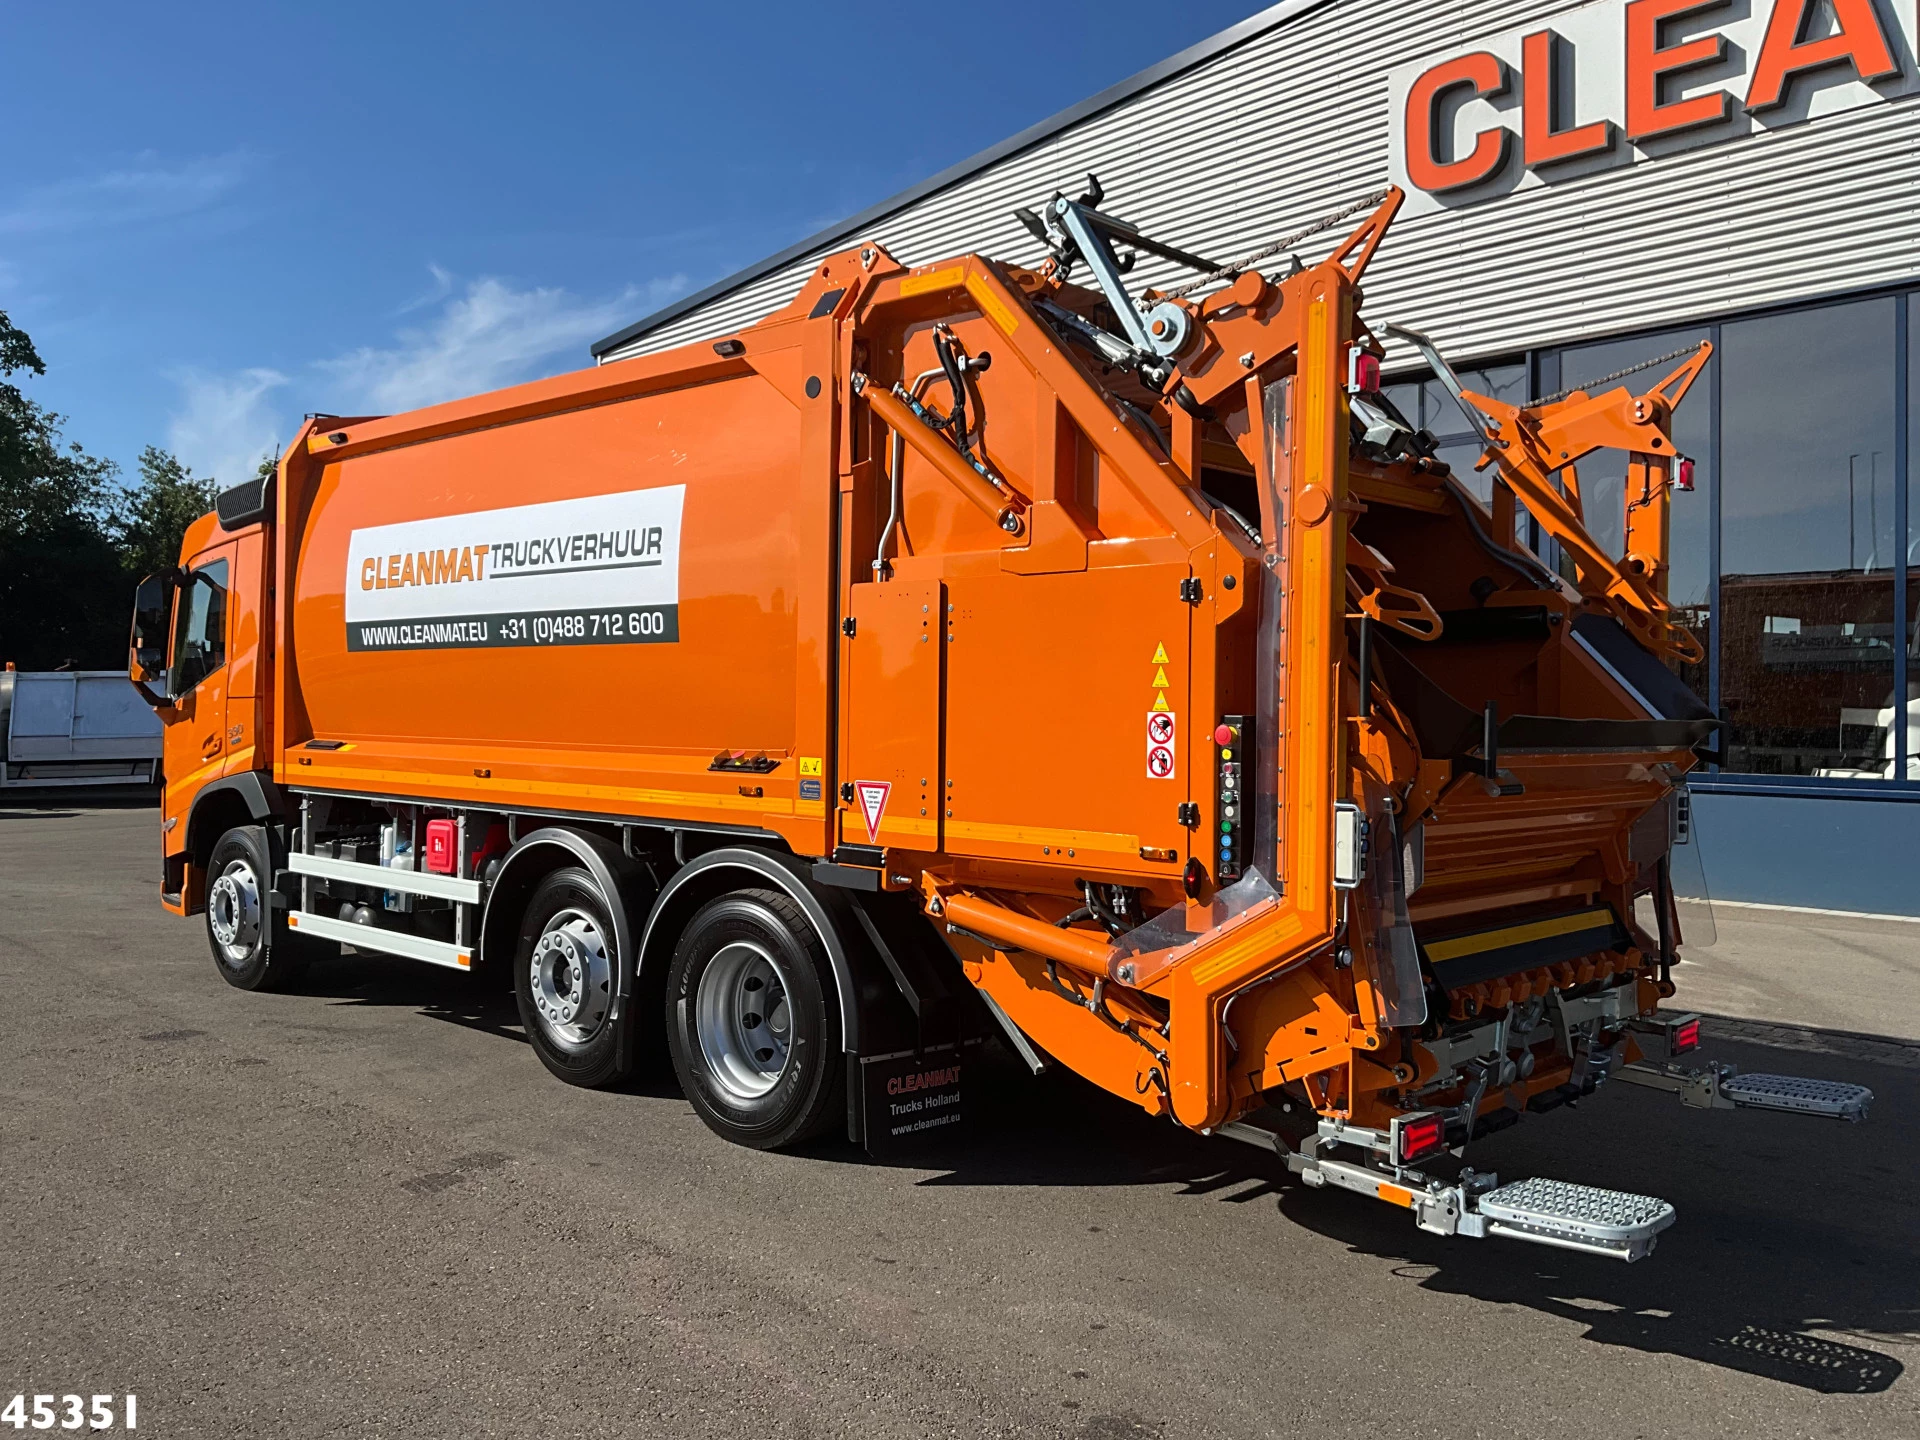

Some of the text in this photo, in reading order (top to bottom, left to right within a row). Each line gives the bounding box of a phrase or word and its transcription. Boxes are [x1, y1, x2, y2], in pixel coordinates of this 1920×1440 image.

[1404, 0, 1920, 193] CLEA
[360, 526, 663, 591] CLEANMAT TRUCKVERHUUR
[361, 611, 664, 646] WWW.CLEANMAT.EU +31 (0)488 712 600
[887, 1065, 961, 1095] CLEANMAT
[890, 1091, 960, 1116] Trucks Holland
[891, 1113, 961, 1136] www.cleanmat.eu
